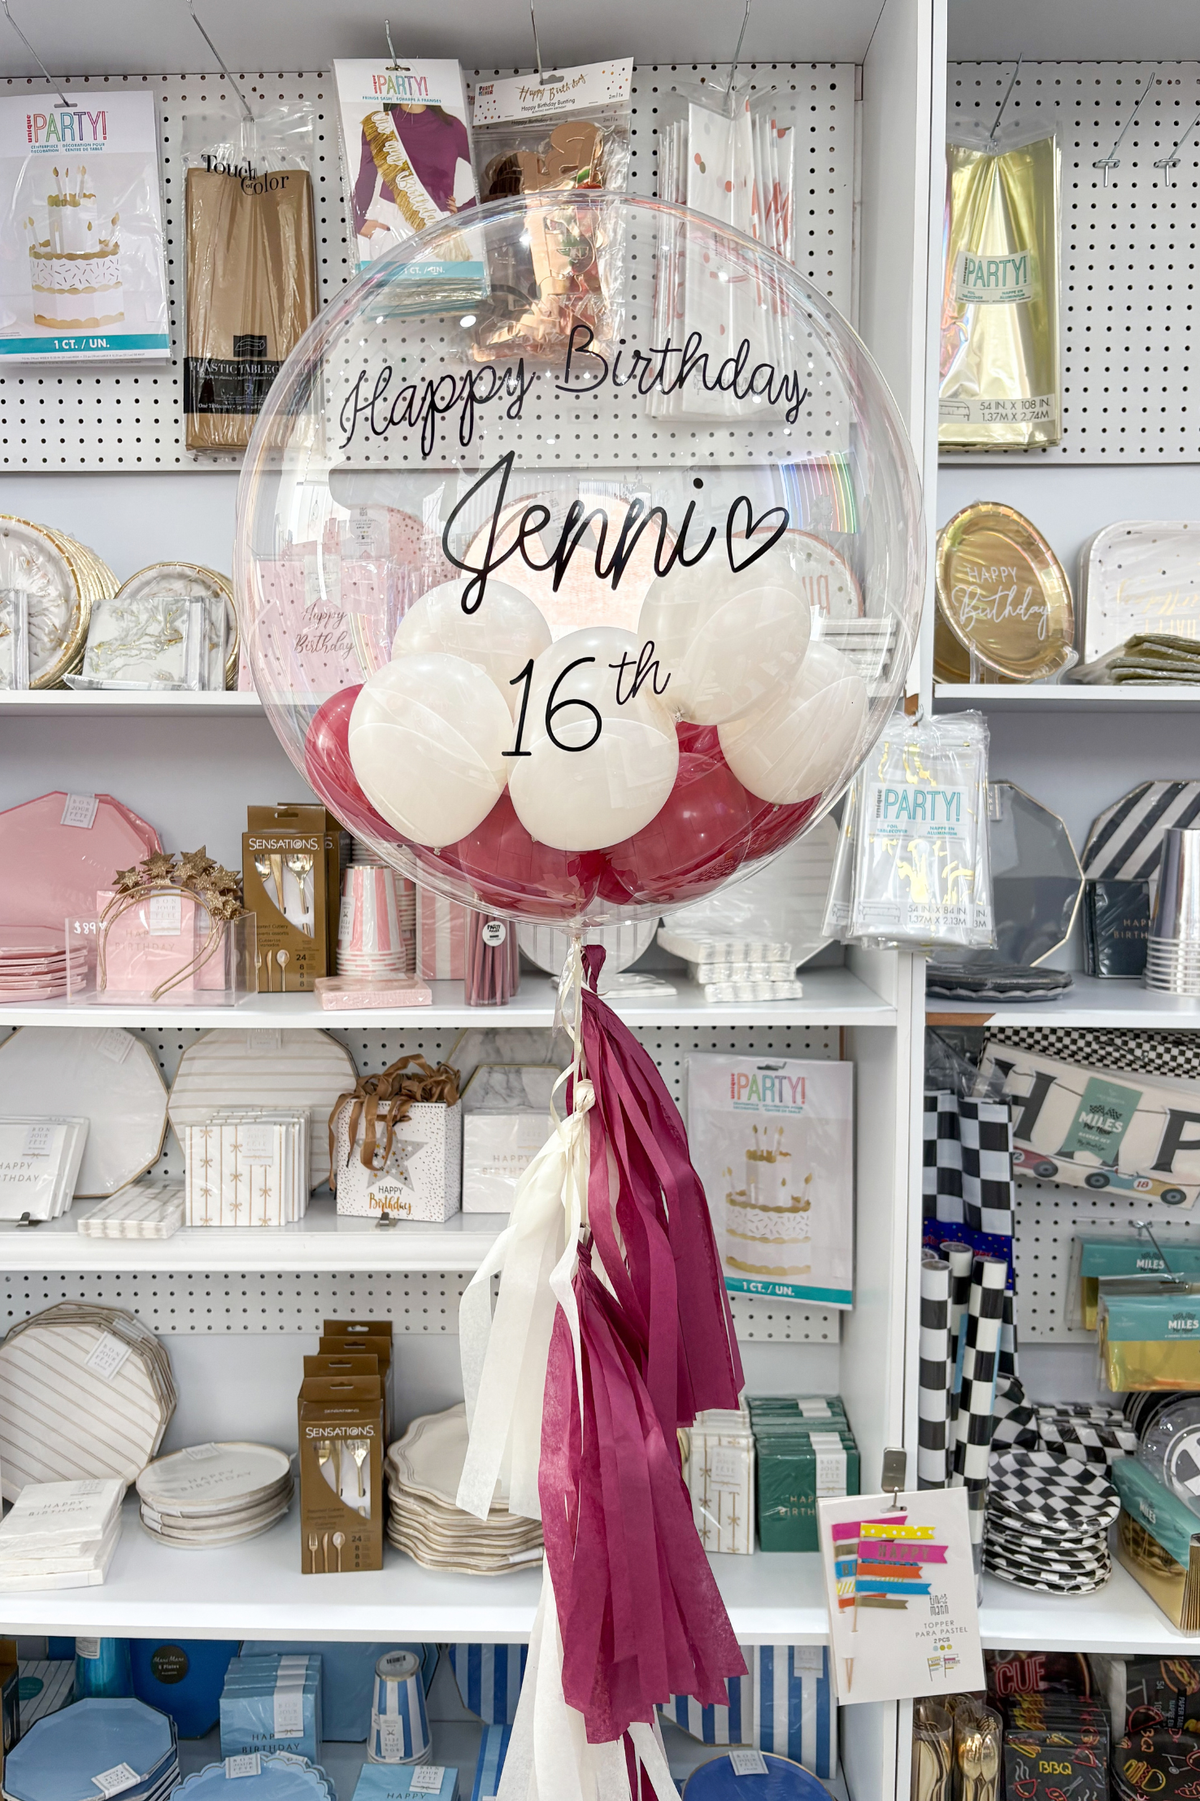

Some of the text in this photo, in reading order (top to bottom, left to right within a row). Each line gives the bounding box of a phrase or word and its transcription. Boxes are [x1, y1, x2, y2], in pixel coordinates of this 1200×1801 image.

[377, 75, 429, 96] PARTY!
[537, 101, 557, 110] Birthday
[33, 111, 107, 143] PARTY!
[201, 154, 257, 181] Touch
[241, 170, 289, 196] Color
[966, 256, 1027, 288] PARTY!
[54, 340, 59, 350] 1
[62, 340, 78, 350] CT.
[89, 338, 110, 349] UN.
[339, 324, 808, 456] Happy Birthday
[980, 398, 1051, 411] 54 IN. X 108 IN.
[982, 410, 1050, 422] 1.37M X 2.74M
[441, 450, 717, 615] Jenni
[967, 566, 1017, 583] HAPPY
[300, 604, 348, 630] Happy
[952, 585, 1052, 641] Birthday
[294, 632, 356, 660] Birthday
[884, 788, 961, 822] PARTY!
[908, 904, 919, 913] 54
[935, 906, 941, 914] X
[944, 906, 955, 915] 84
[935, 916, 941, 925] X
[944, 917, 966, 926] 2.13M
[1123, 918, 1151, 927] HAP
[74, 920, 97, 935] $89
[126, 930, 149, 938] HAP
[1114, 930, 1148, 939] BIRTH
[115, 942, 175, 951] BIRTHDAY
[737, 1073, 806, 1105] PARTY!
[1079, 1112, 1124, 1133] MILES
[493, 1154, 531, 1163] HAPPY
[3, 1174, 40, 1182] THDAY
[378, 1186, 404, 1195] HAPPY
[1137, 1180, 1149, 1189] 18
[368, 1192, 412, 1215] Birthday
[1136, 1259, 1165, 1269] MILES
[742, 1282, 748, 1290] 1
[750, 1282, 766, 1293] CT.
[775, 1286, 795, 1296] UN.
[1168, 1320, 1200, 1330] MILES
[180, 1472, 251, 1491] BIRTHDAY
[188, 1470, 233, 1484] HAPPY
[44, 1500, 84, 1509] HAPPY
[28, 1506, 92, 1516] BIRTHDAY
[780, 1508, 815, 1516] BIRTH
[878, 1544, 930, 1561] HAPPY
[924, 1620, 955, 1630] TOPPER
[940, 1627, 968, 1635] PASTEL
[996, 1656, 1047, 1695] CUE
[252, 1733, 274, 1742] HAP
[242, 1742, 300, 1753] BIRTHDAY
[1039, 1760, 1072, 1775] BBQ
[386, 1792, 426, 1800] HAPPY
